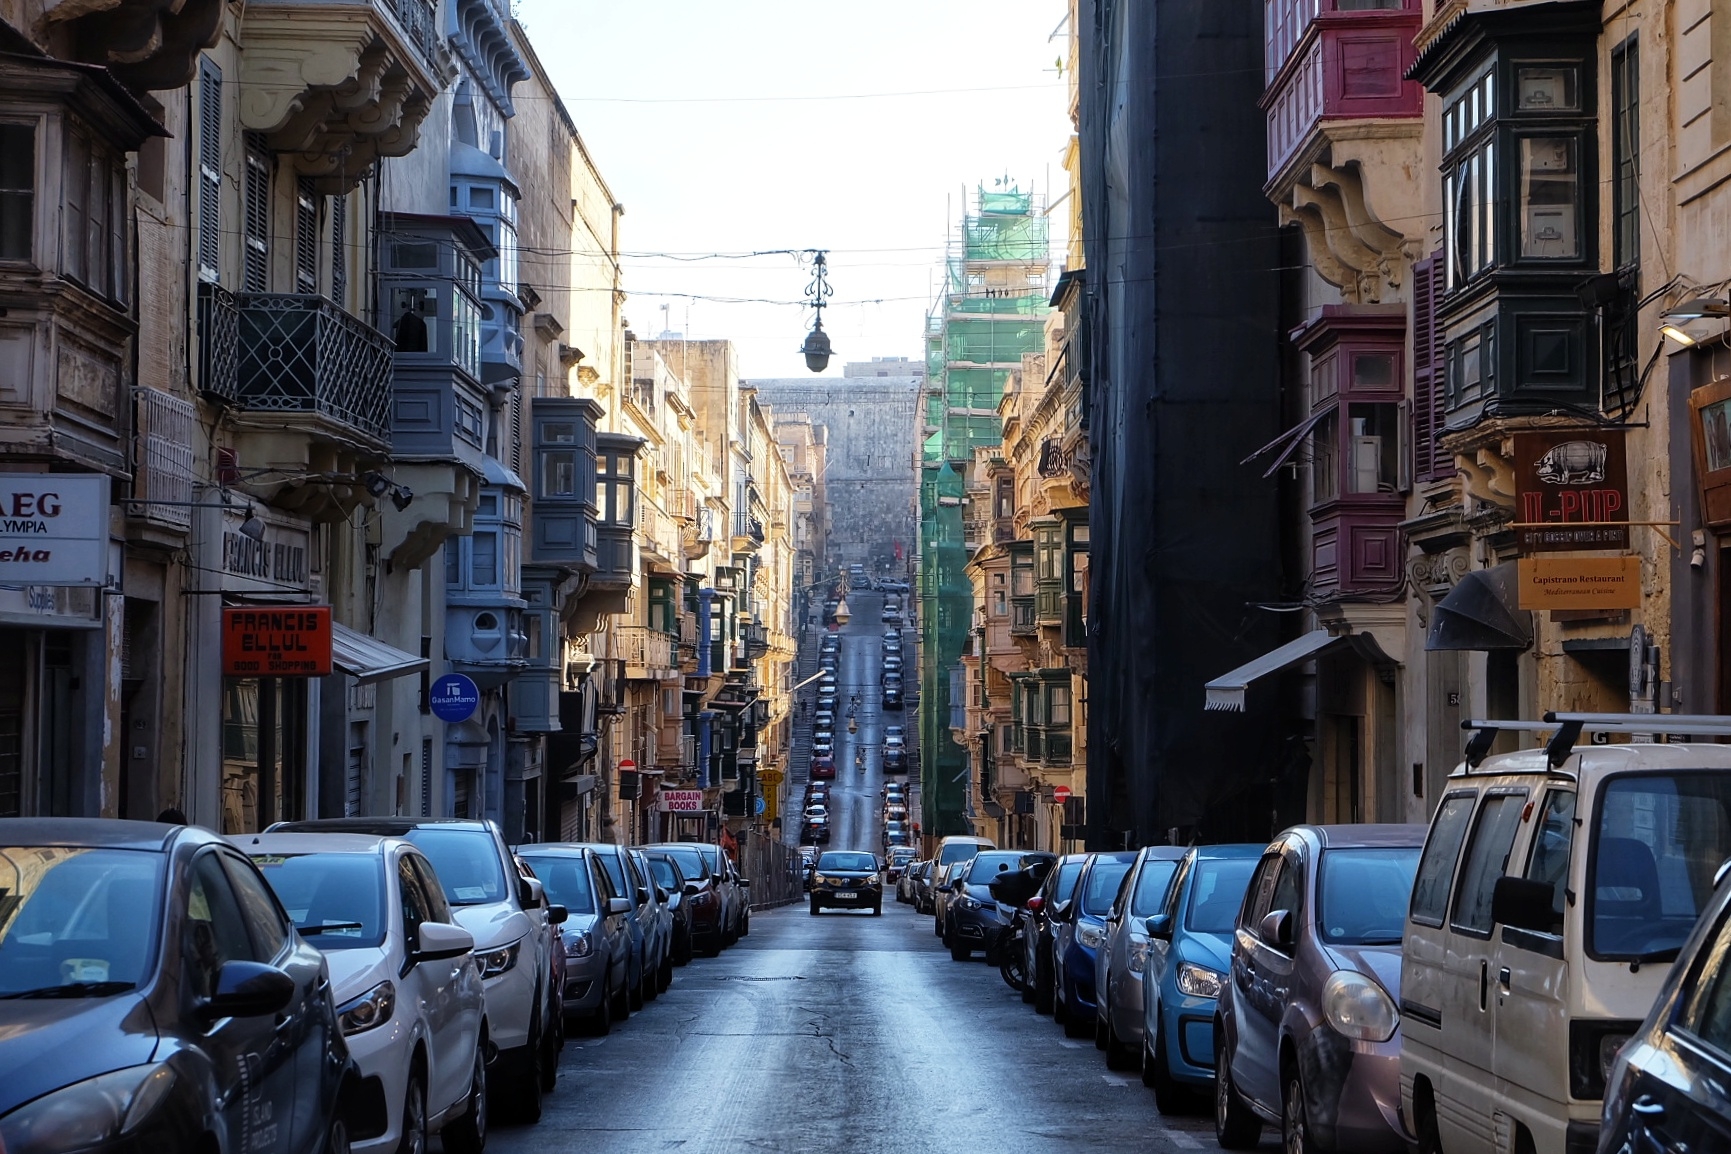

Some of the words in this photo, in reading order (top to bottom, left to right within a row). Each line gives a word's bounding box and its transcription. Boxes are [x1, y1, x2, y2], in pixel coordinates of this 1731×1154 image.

[1522, 490, 1622, 528] IL-PUP
[0, 520, 47, 534] YMPIA
[1533, 576, 1578, 585] Capistrano
[1579, 575, 1625, 584] Restaurant
[1543, 588, 1591, 596] Mediterranean
[1592, 587, 1616, 595] Cuisine
[231, 613, 318, 631] FRANCIS
[241, 634, 308, 652] ELLUL
[233, 660, 260, 671] GOOD
[268, 660, 317, 671] SHOPPING
[431, 695, 476, 704] GasanMamo
[762, 773, 778, 782] ABC
[664, 792, 701, 801] BARGAIN
[668, 801, 697, 810] BOOKS
